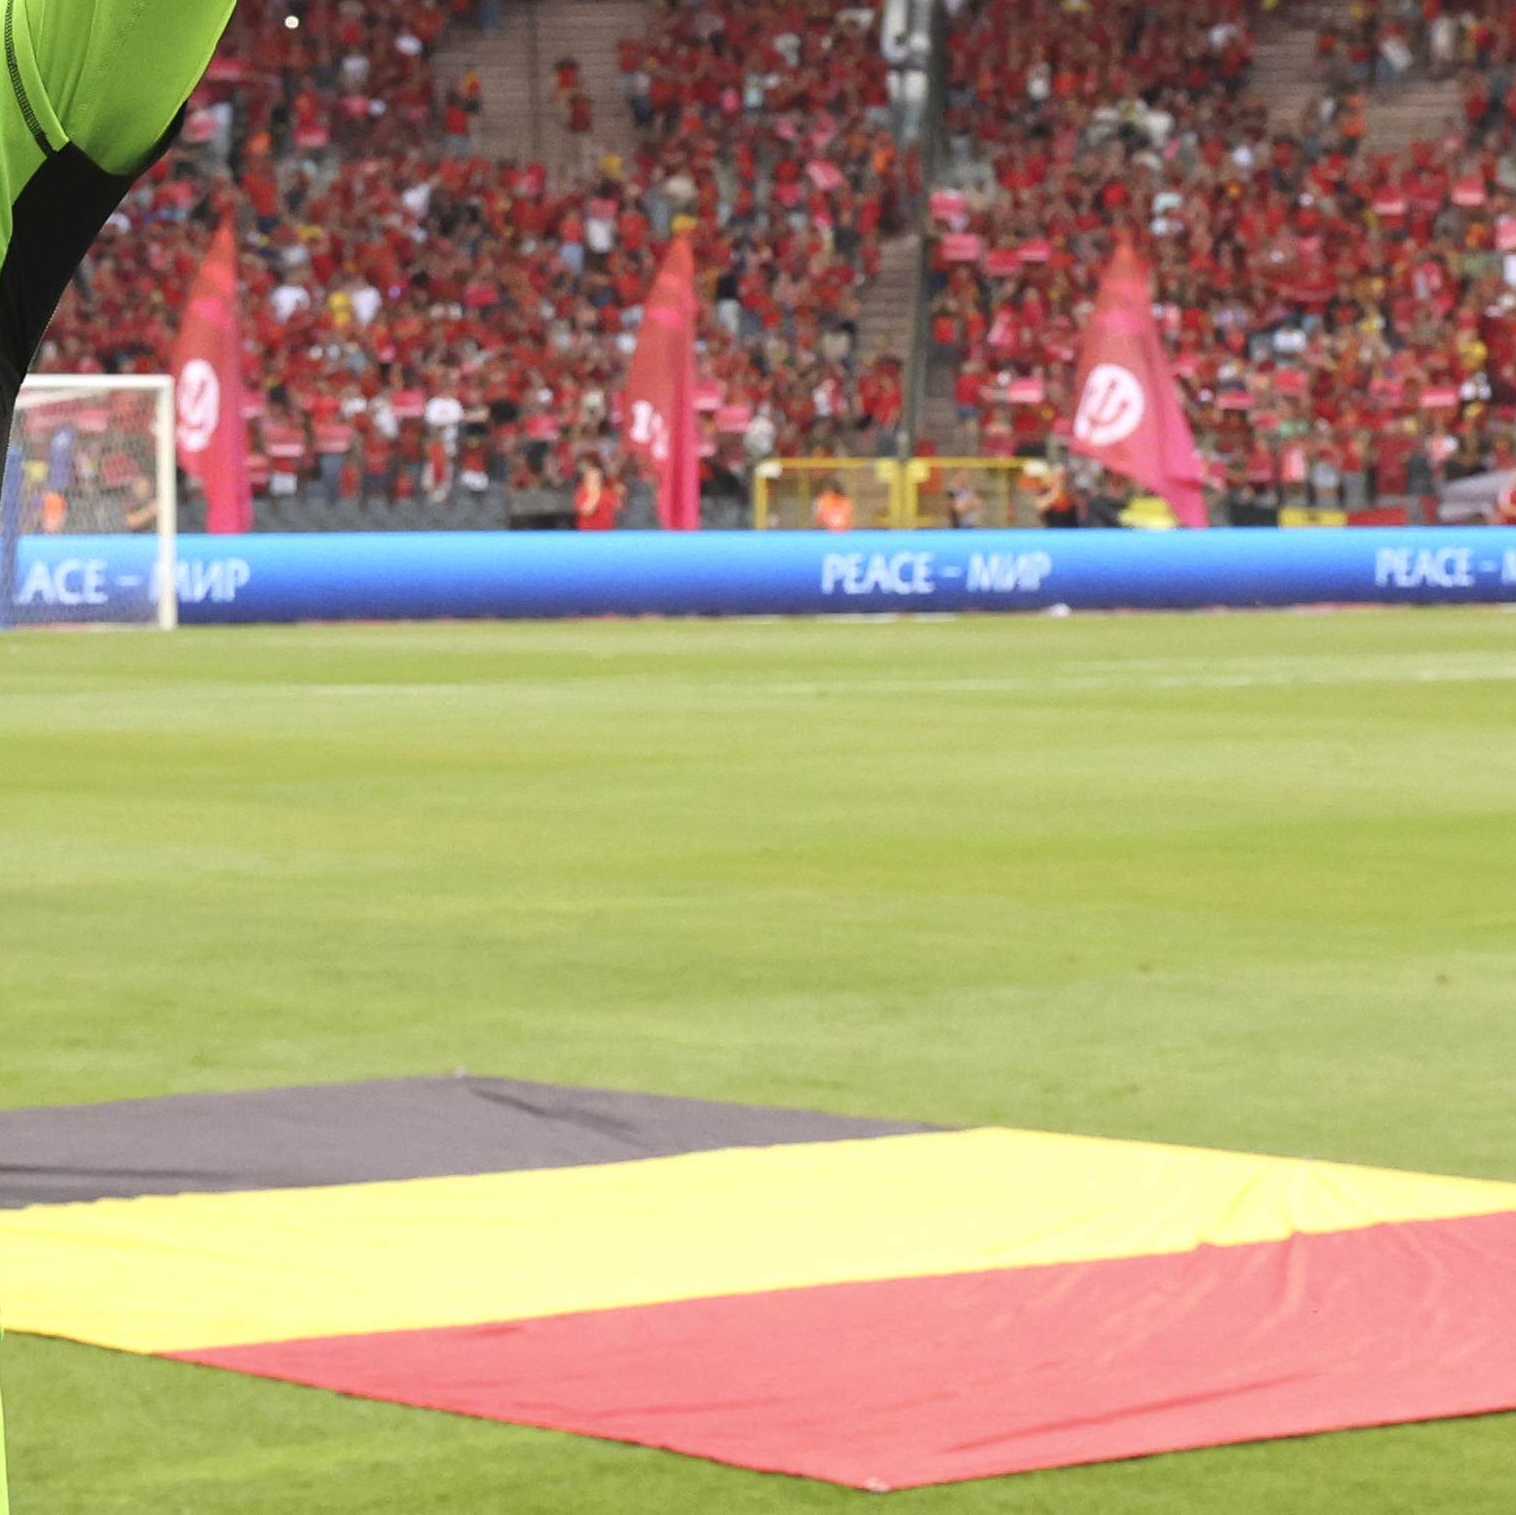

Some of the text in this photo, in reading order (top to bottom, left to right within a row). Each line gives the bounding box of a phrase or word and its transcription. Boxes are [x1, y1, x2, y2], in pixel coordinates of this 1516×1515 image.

[14, 557, 109, 605] ACE
[821, 551, 934, 595] PEACE
[1375, 546, 1476, 588] PEACE
